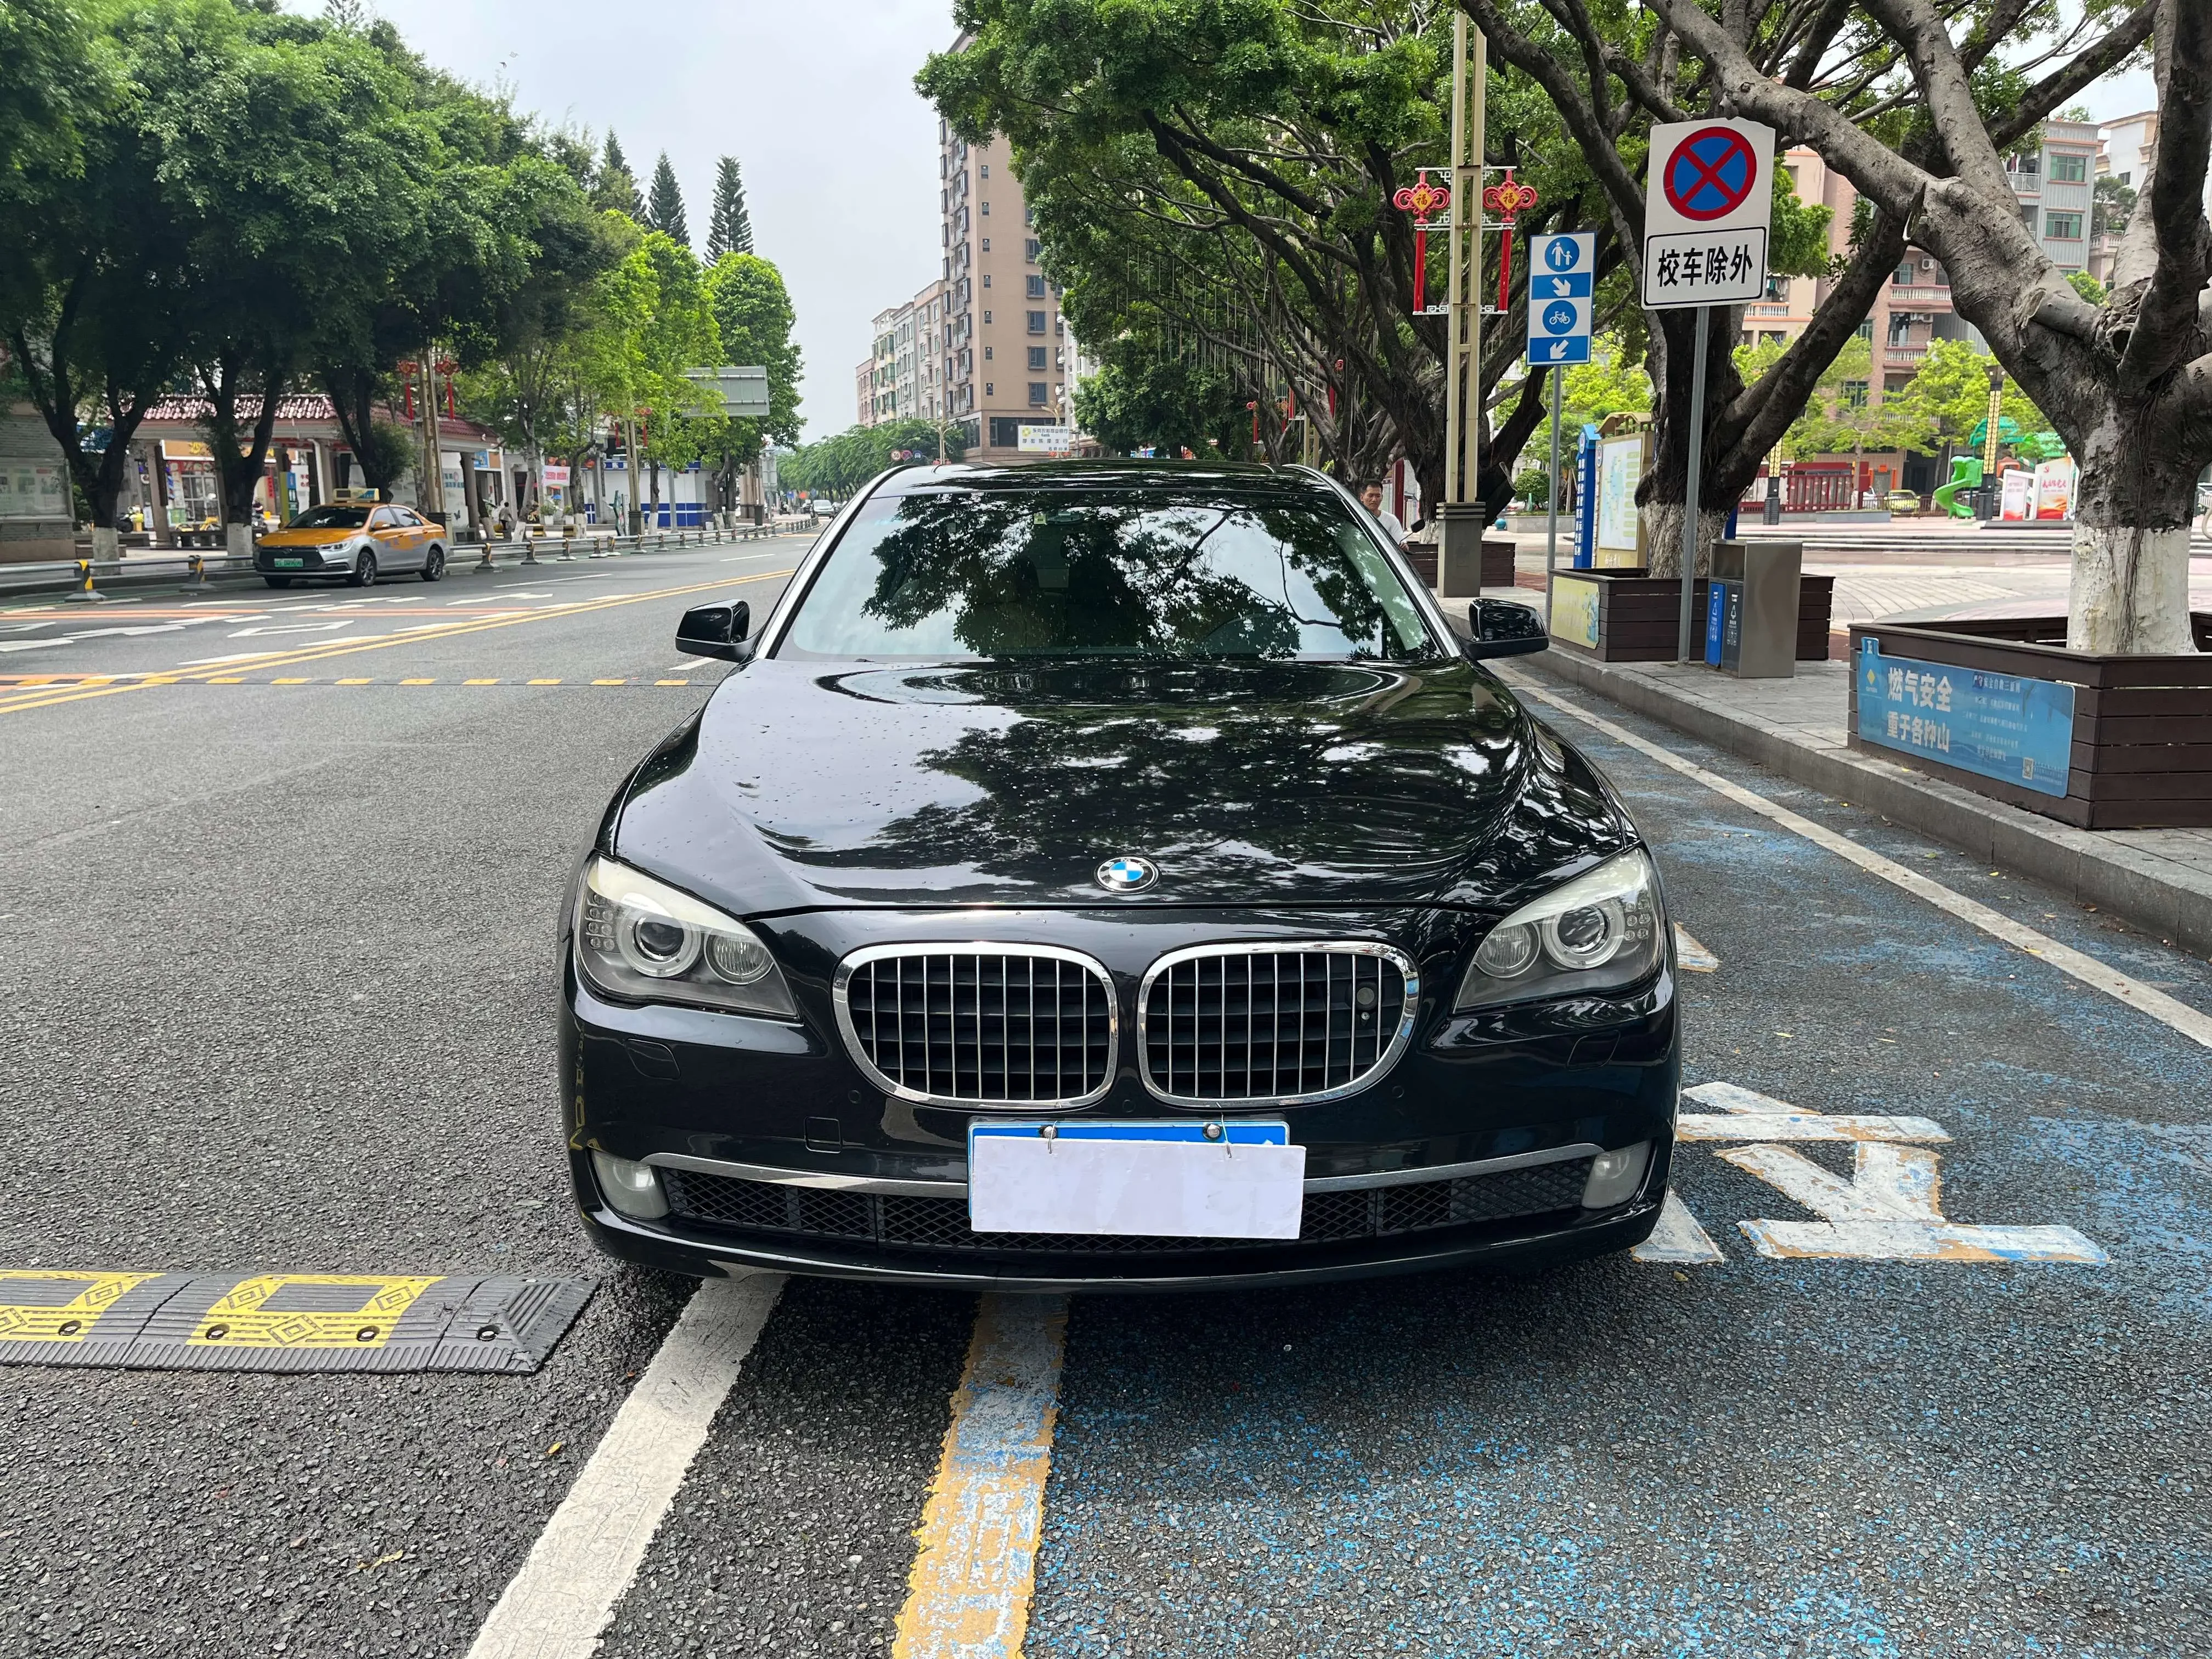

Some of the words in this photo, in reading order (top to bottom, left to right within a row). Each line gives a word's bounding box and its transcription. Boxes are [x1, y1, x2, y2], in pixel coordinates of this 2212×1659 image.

[1416, 194, 1427, 205] 福
[1503, 193, 1515, 205] 福
[1657, 244, 1753, 287] 校车除外
[1888, 667, 1953, 712] 燃气安全
[1887, 710, 1950, 753] 重于各种山
